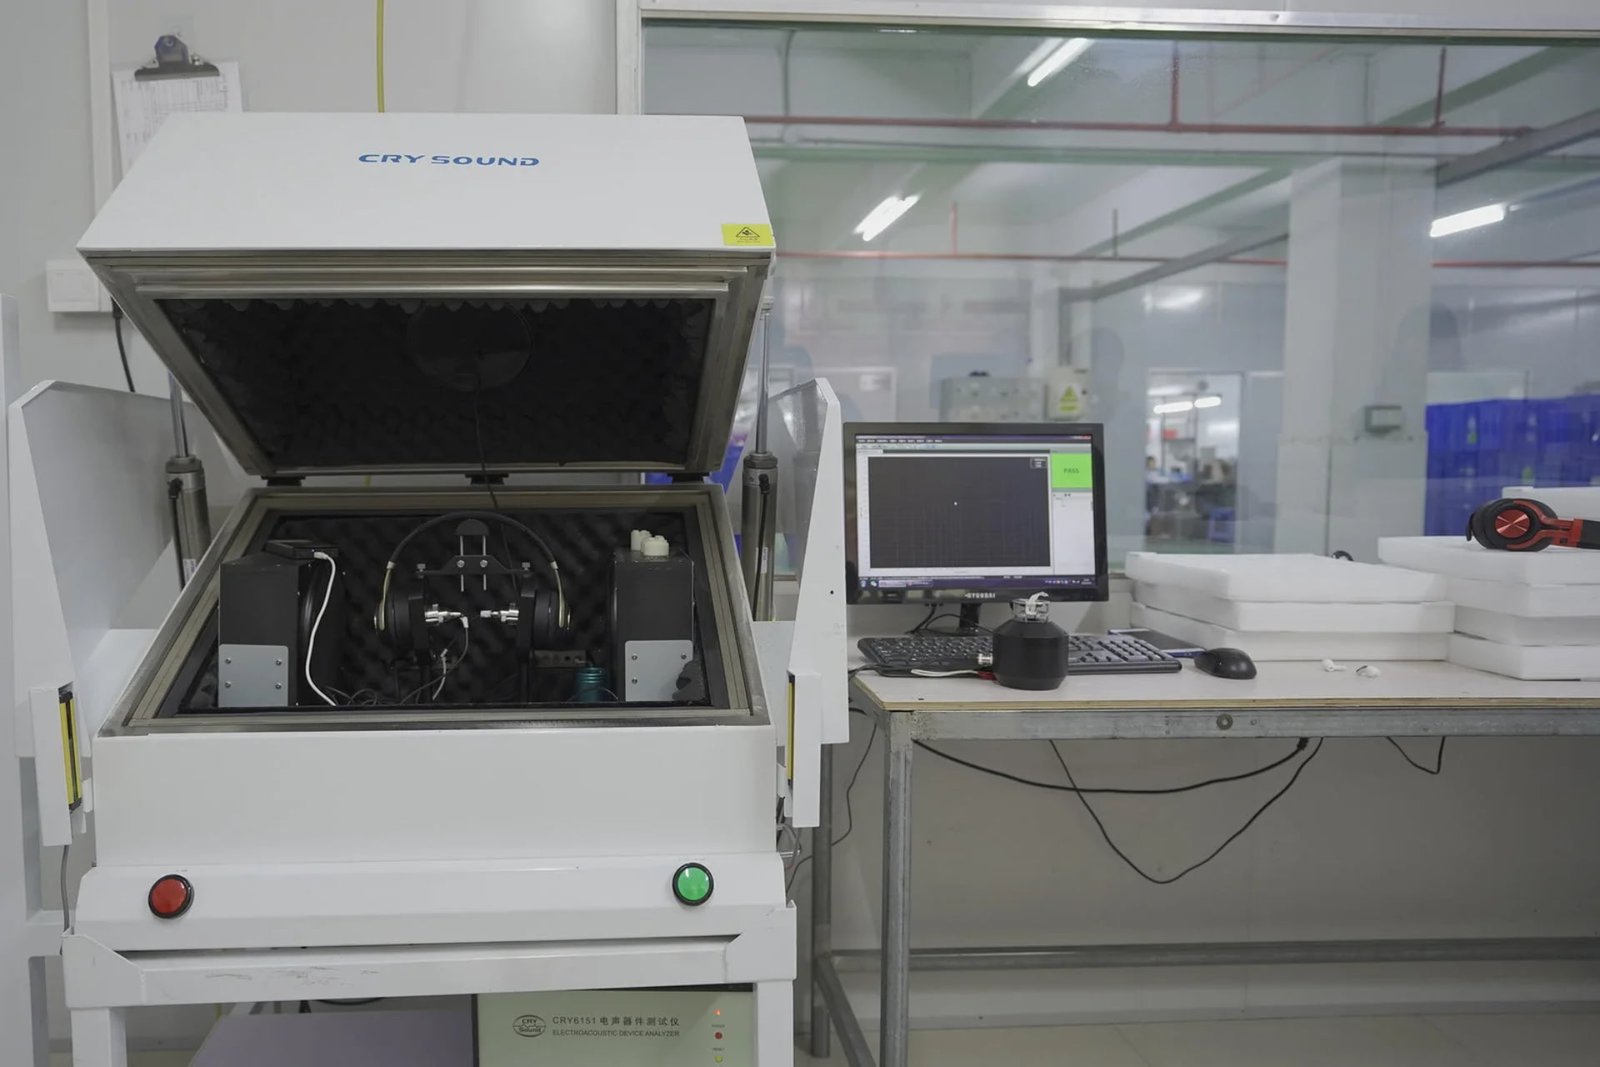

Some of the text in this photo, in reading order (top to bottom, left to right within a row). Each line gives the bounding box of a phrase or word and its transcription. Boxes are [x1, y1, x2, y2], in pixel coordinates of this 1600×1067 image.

[552, 1016, 680, 1027] CRY6151 电声器件测试仪
[552, 1029, 617, 1037] ELECTROACOUSTIC
